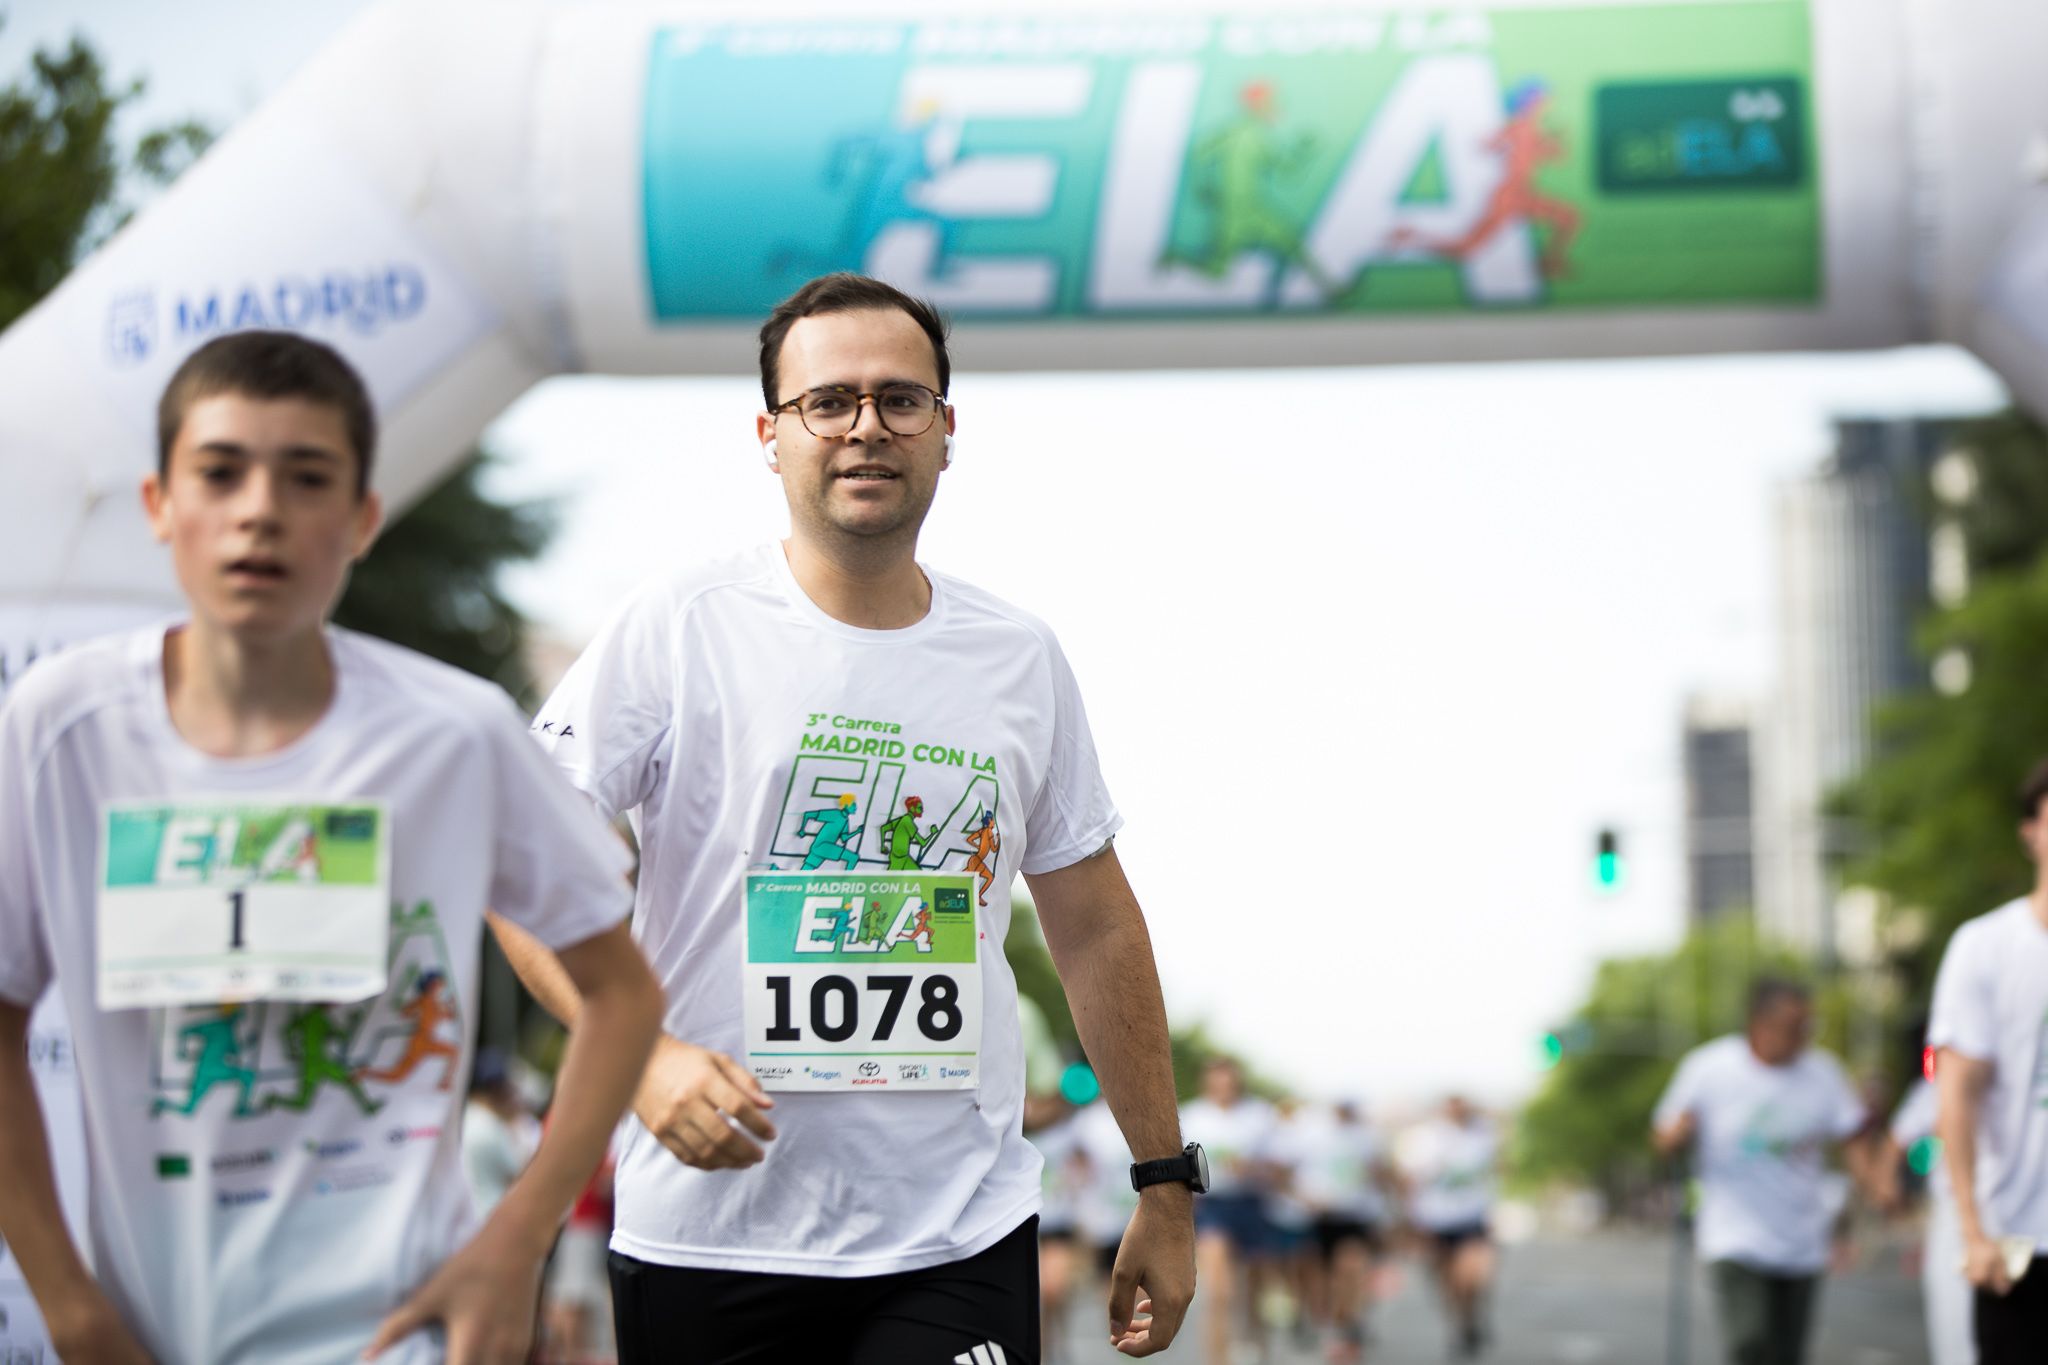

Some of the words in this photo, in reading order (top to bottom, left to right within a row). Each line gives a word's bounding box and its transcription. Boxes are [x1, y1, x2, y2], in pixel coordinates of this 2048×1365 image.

[864, 54, 1545, 308] ELA
[172, 266, 428, 337] MADRID
[800, 733, 906, 759] MADRID
[912, 744, 965, 767] CON
[970, 752, 997, 775] LA
[832, 715, 902, 734] Carrera
[770, 755, 1000, 873] ELA
[156, 818, 320, 886] ELA
[805, 882, 866, 895] MADRID
[869, 883, 900, 894] CON
[902, 883, 922, 894] LA
[228, 892, 246, 948] 1
[795, 896, 933, 953] ELA
[766, 974, 963, 1042] 1078
